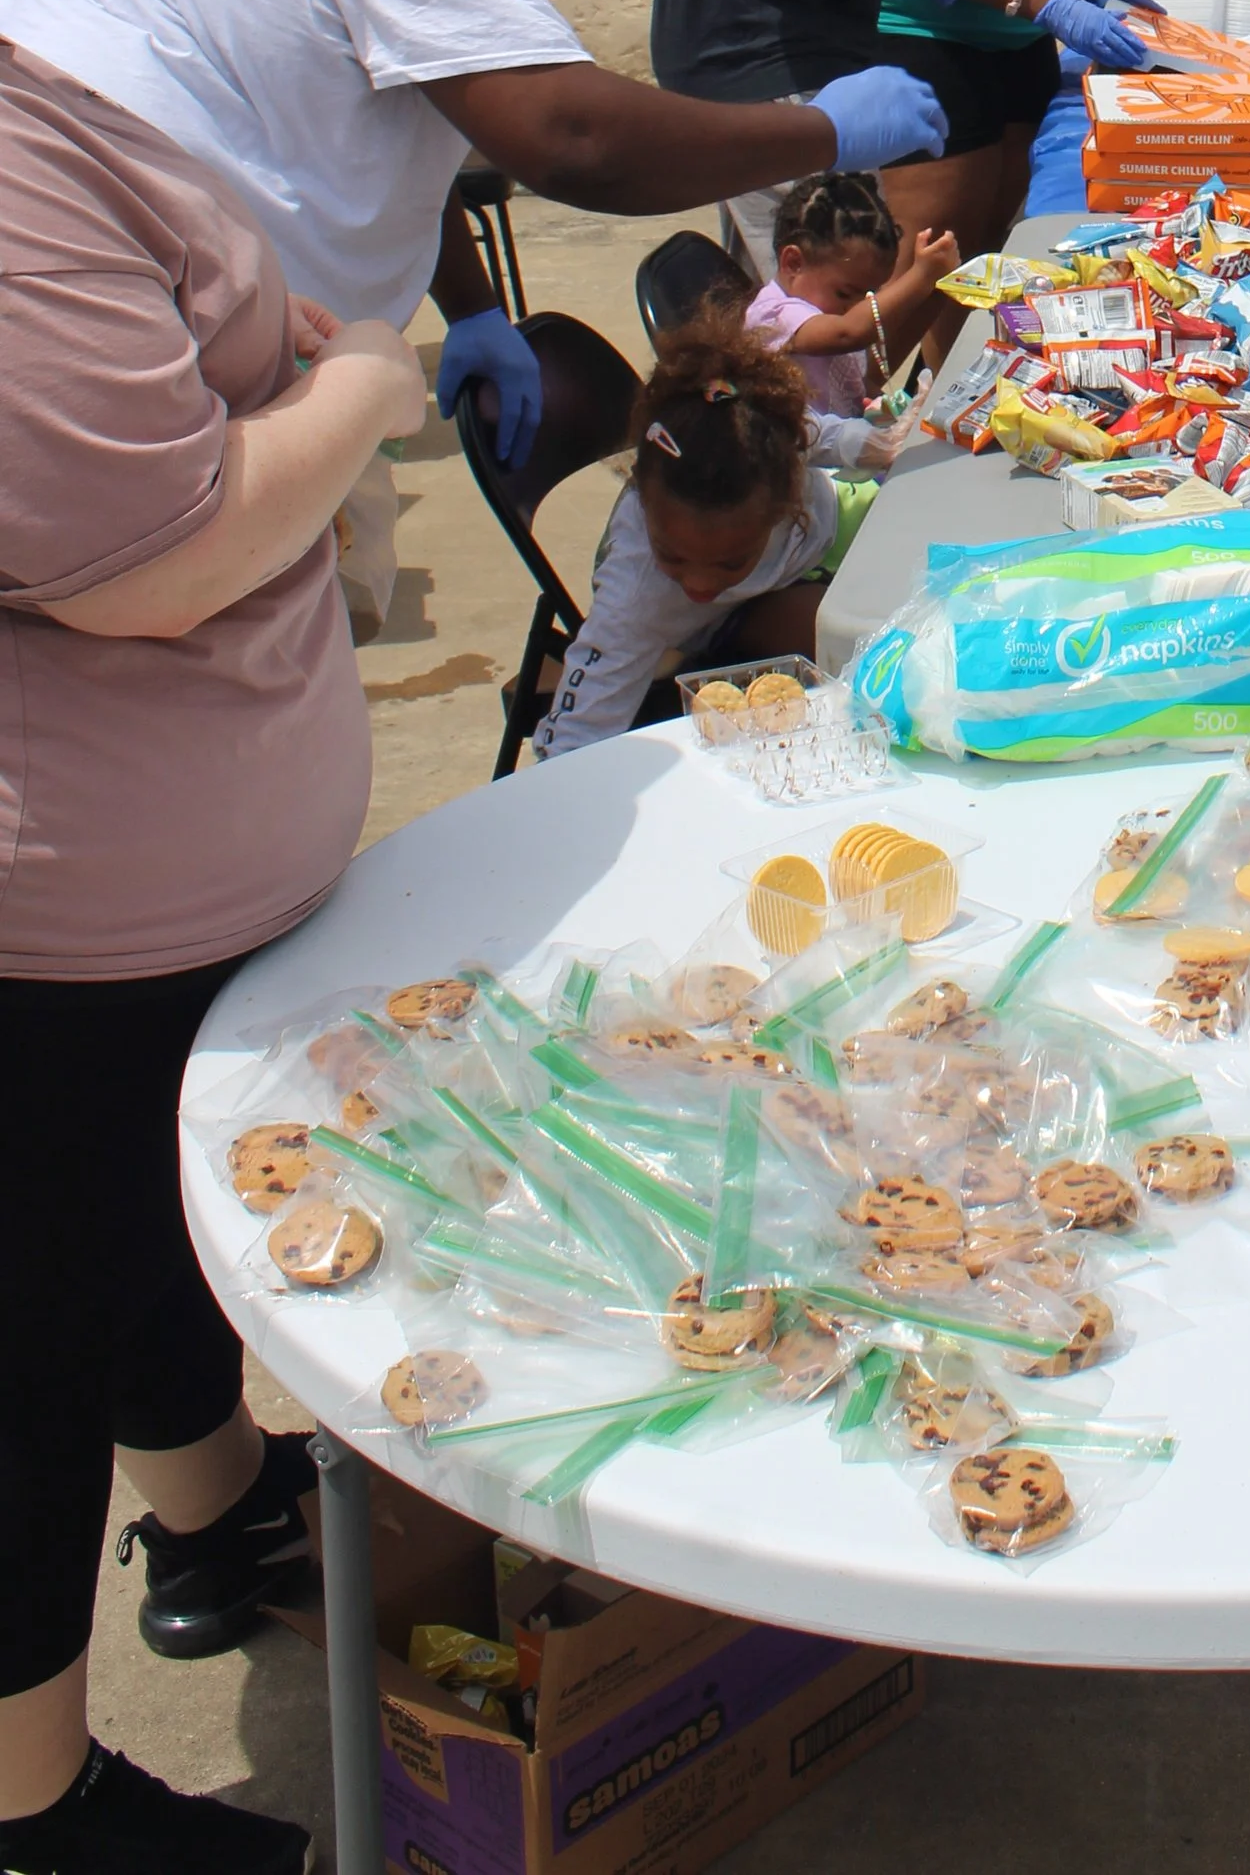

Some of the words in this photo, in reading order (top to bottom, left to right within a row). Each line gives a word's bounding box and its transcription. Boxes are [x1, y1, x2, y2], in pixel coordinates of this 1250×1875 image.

[1135, 134, 1185, 145] SUMMER
[1187, 134, 1234, 145] CHILLIN'
[1119, 163, 1169, 175] SUMMER
[1171, 165, 1217, 177] CHILLIN'
[1124, 196, 1152, 207] SUM
[1004, 639, 1051, 657] simply
[1119, 629, 1236, 665] napkins
[1011, 655, 1047, 668] done
[1193, 711, 1237, 731] 500
[567, 1708, 723, 1831] samoas
